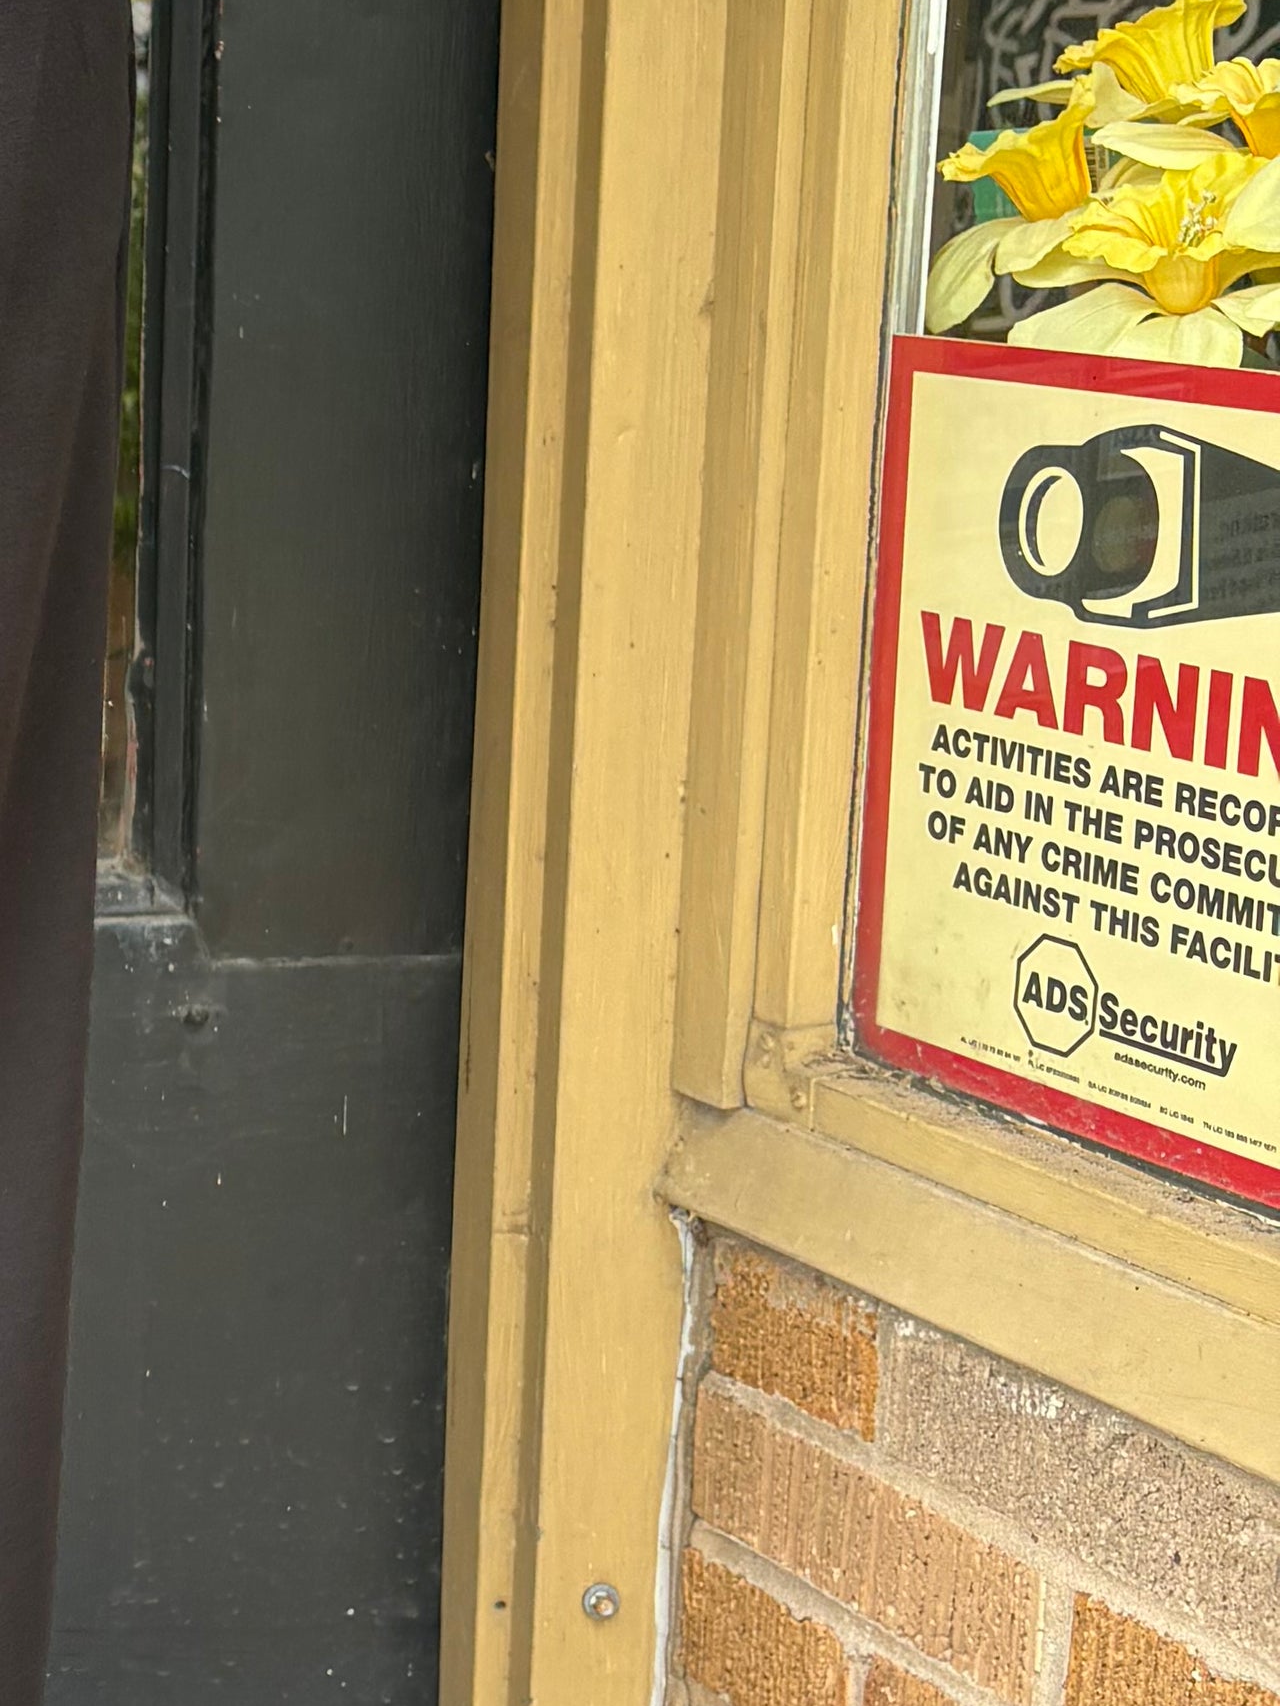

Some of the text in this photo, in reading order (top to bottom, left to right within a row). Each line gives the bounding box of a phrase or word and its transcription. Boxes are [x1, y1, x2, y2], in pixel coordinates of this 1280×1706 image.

[918, 762, 958, 799] TO
[964, 776, 1015, 813] AID
[1024, 790, 1054, 826] IN
[1063, 800, 1124, 844] THE
[930, 723, 1093, 789] ACTIVITIES
[1099, 764, 1165, 808] ARE
[927, 810, 966, 844] OF
[972, 822, 1034, 864] ANY
[1040, 841, 1141, 896] CRIME
[952, 861, 1280, 987] AGAINST THIS FACILI
[1022, 970, 1238, 1077] ADS Security
